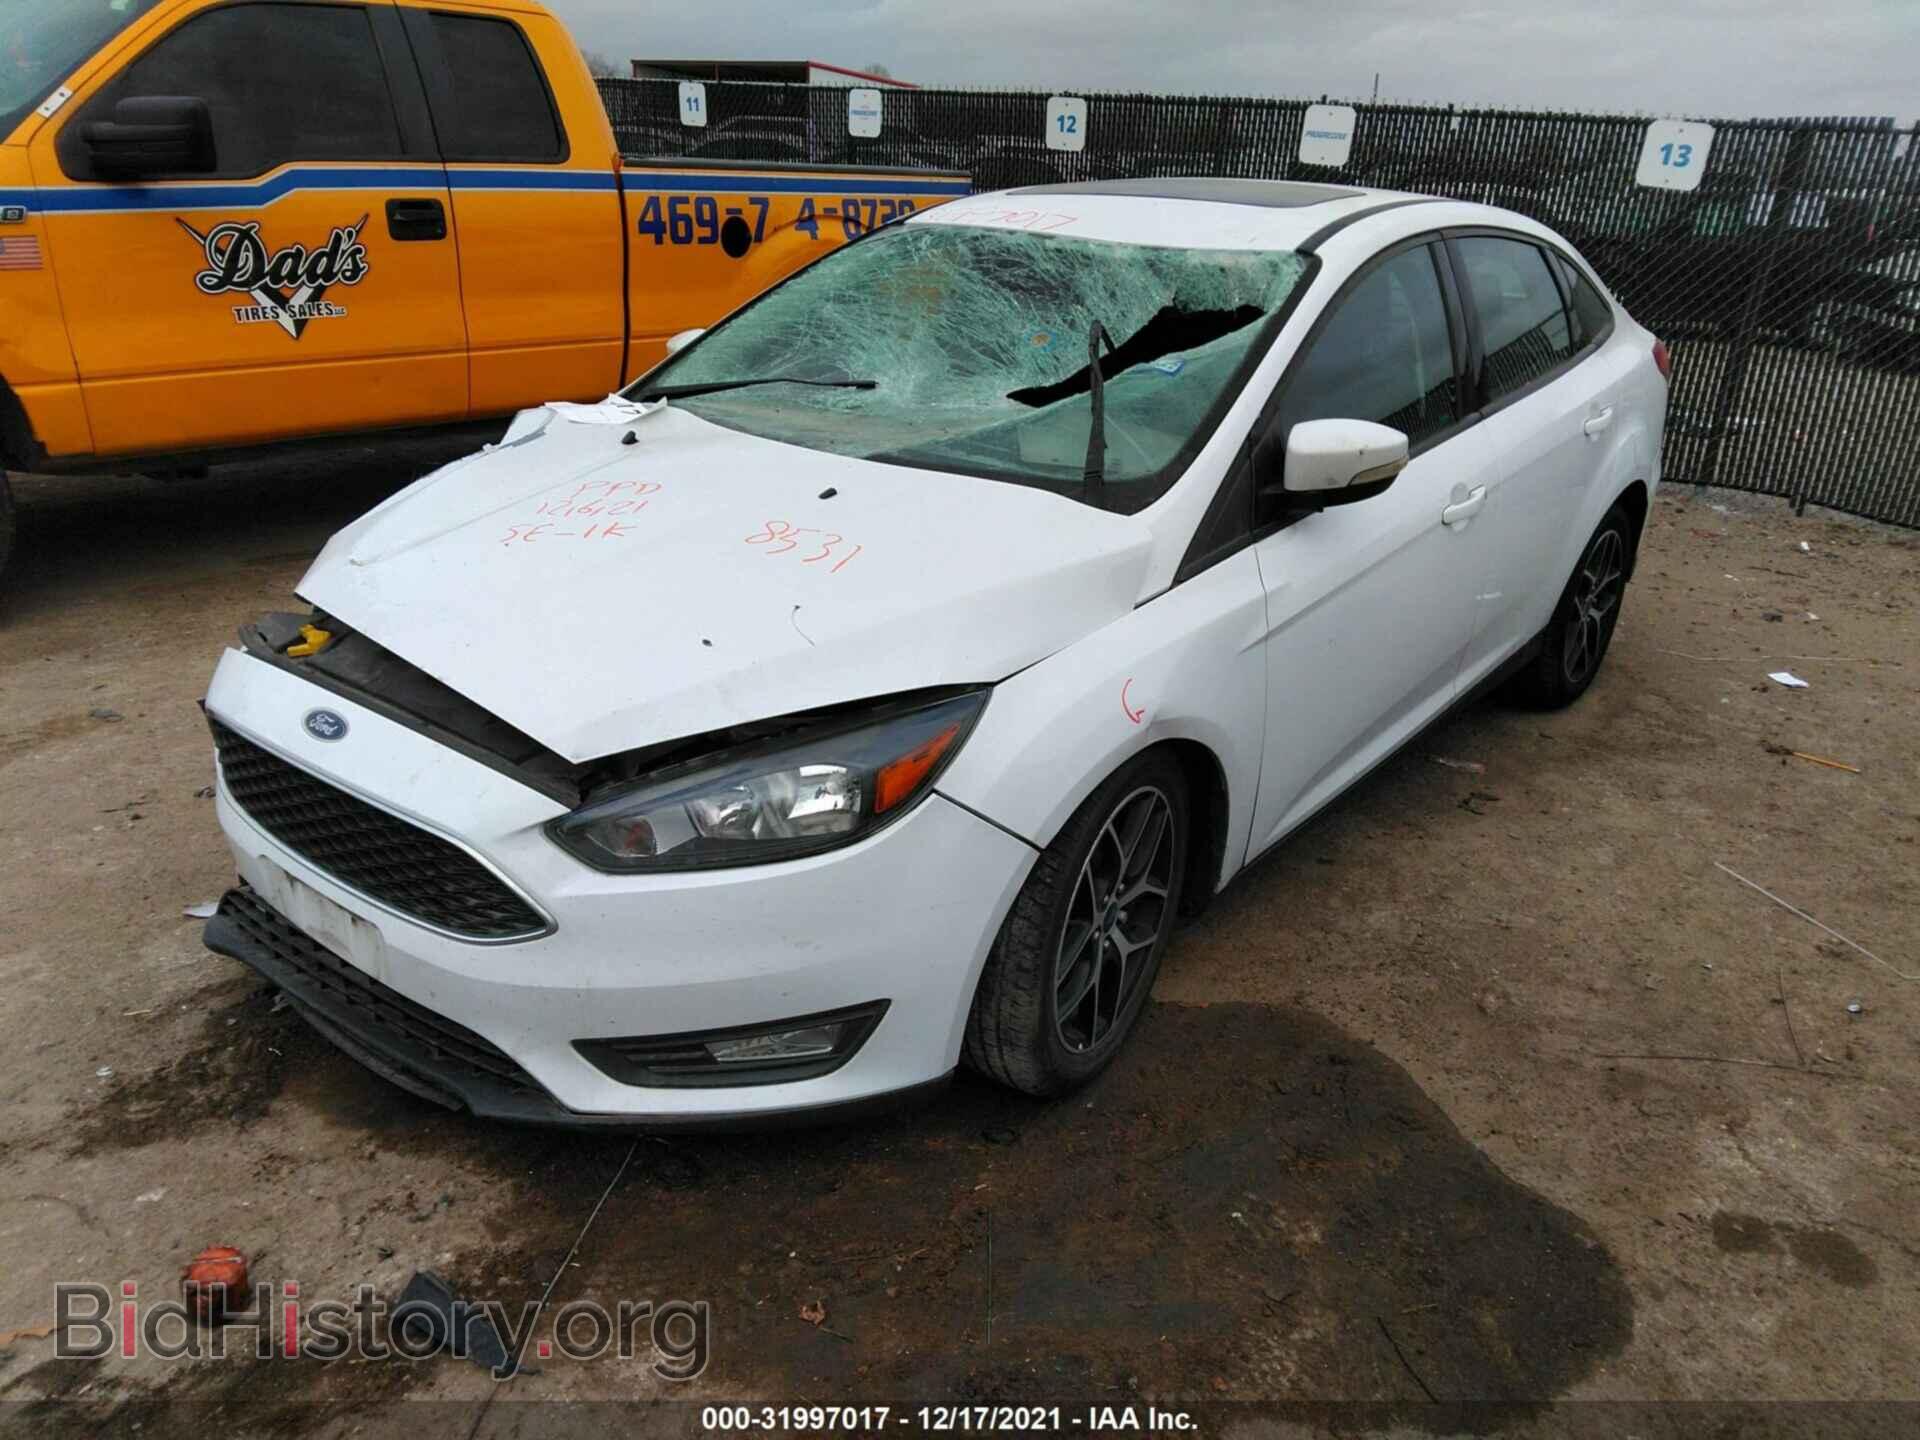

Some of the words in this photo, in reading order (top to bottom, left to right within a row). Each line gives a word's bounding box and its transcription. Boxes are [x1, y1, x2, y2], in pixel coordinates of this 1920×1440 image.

[686, 97, 700, 112] 11
[1057, 114, 1076, 133] 12
[1660, 143, 1693, 168] 13
[196, 222, 368, 294] Dad's
[233, 305, 280, 322] TIRES
[287, 302, 335, 319] SALES
[744, 519, 862, 574] 8531
[310, 713, 339, 736] Ford
